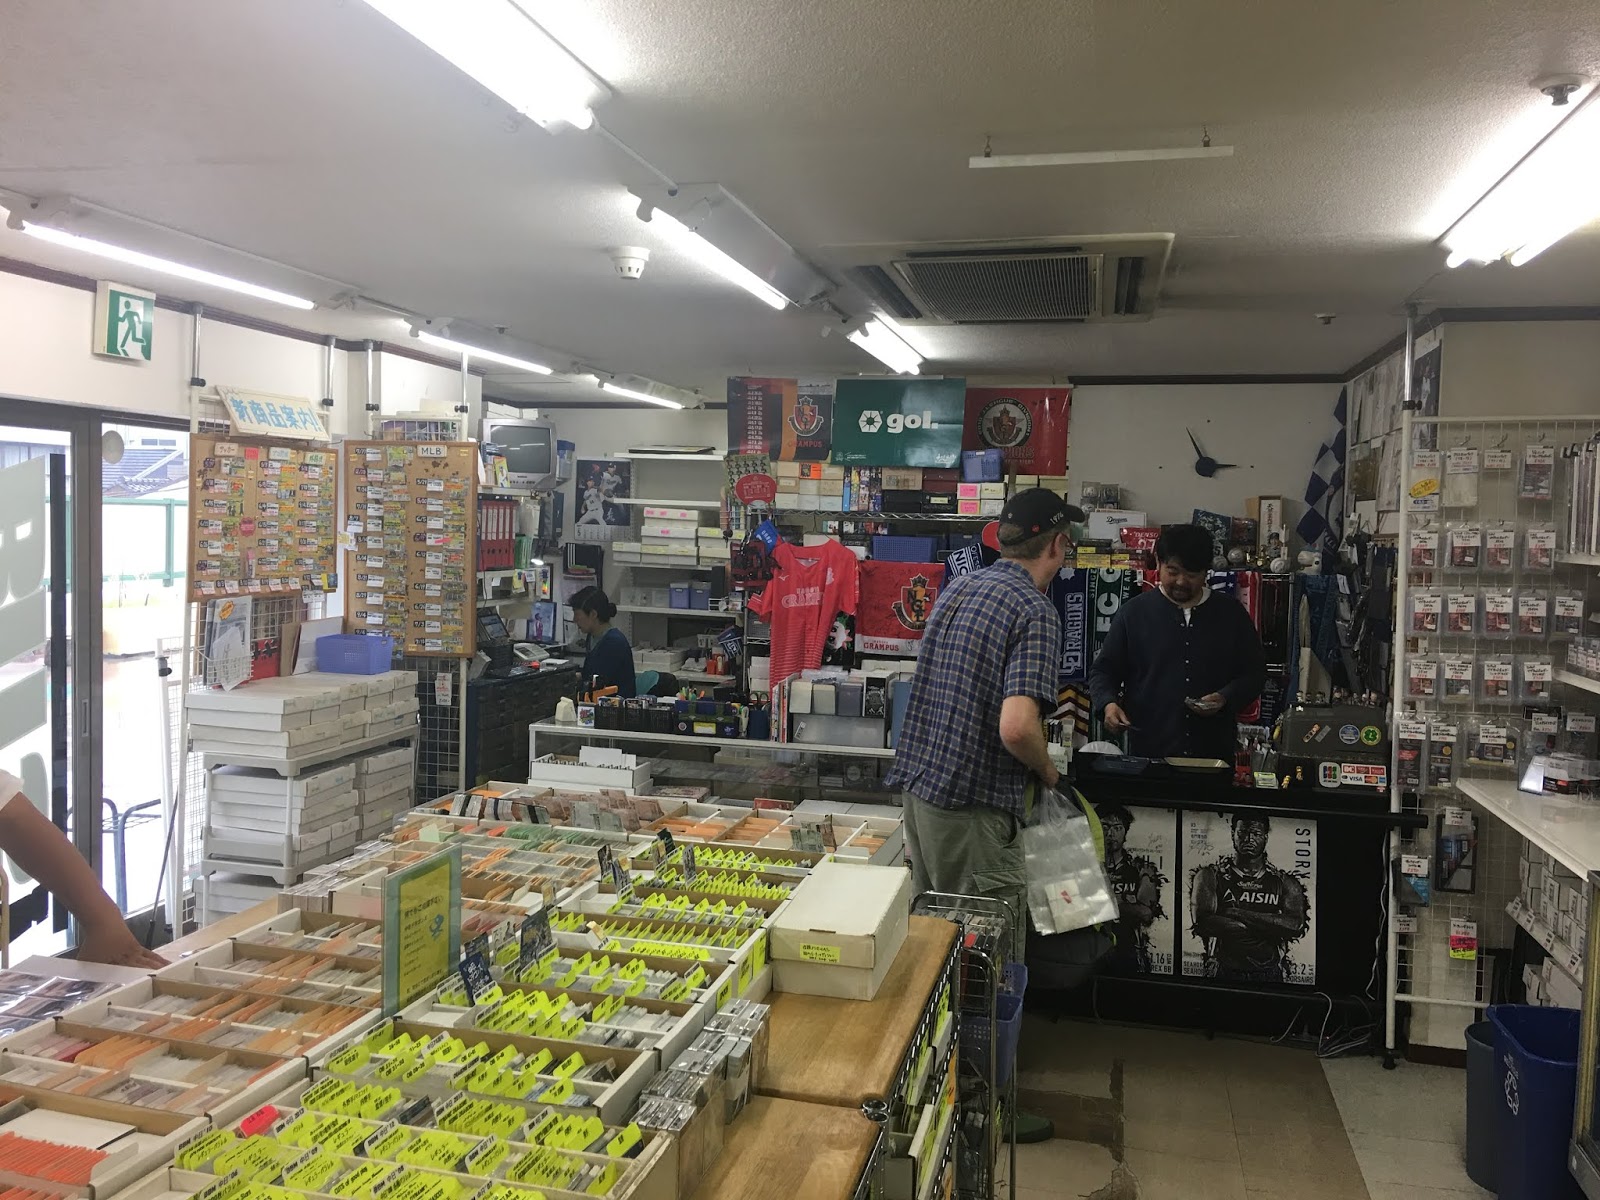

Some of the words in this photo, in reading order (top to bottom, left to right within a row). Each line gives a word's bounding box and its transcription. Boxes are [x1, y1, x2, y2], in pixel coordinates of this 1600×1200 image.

[863, 642, 900, 652] GRAMPUS
[1295, 828, 1311, 879] STORY
[1240, 891, 1280, 905] AISIN
